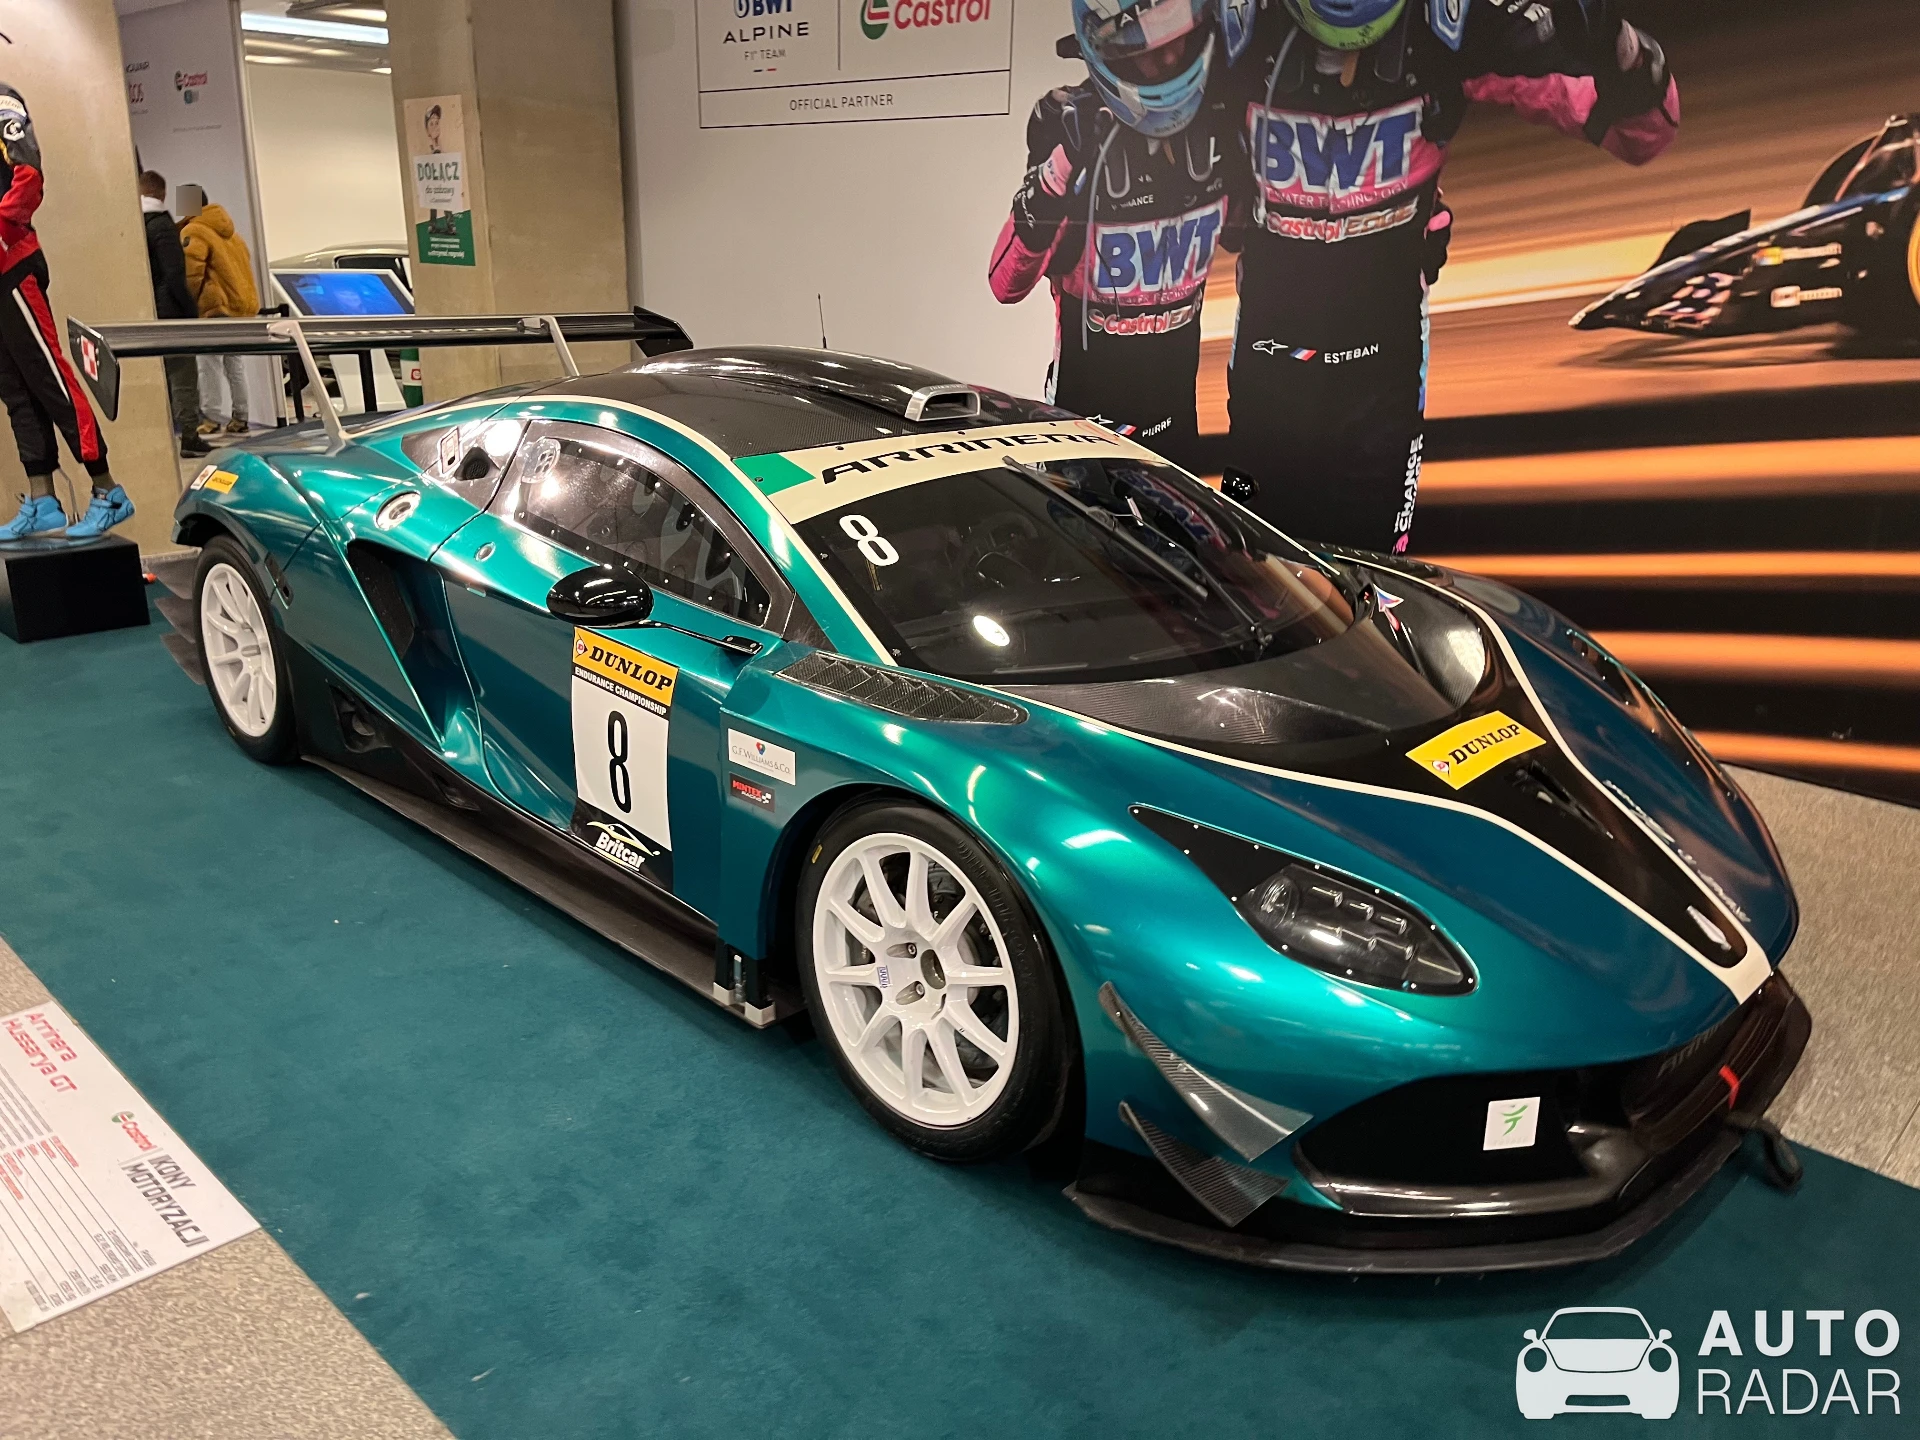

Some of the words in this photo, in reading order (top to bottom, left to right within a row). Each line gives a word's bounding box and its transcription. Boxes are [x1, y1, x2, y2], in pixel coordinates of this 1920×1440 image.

[722, 22, 809, 44] ALPINE
[893, 0, 991, 30] Castrol
[760, 48, 787, 60] TEAM
[789, 97, 839, 111] OFFICIAL
[841, 94, 894, 108] PARTNER
[1255, 110, 1418, 191] BWT
[1267, 211, 1344, 243] Castrol
[1097, 208, 1221, 289] BWT
[1105, 312, 1169, 334] Castrol
[1324, 343, 1380, 364] ESTEBAN
[1142, 416, 1172, 437] PIERRE
[822, 432, 1121, 485] ARRINERA
[839, 514, 899, 567] 8
[589, 646, 673, 690] DUNLOP
[575, 666, 615, 691] ENDURANCE
[615, 685, 667, 715] CHAMPIONSHIP
[607, 710, 632, 813] 8
[1448, 723, 1521, 765] DUNLOP
[732, 779, 763, 798] MINTEX
[595, 831, 646, 870] Britcar
[1, 1017, 58, 1076] Hussarya
[49, 1074, 78, 1093] GT
[24, 1013, 78, 1062] Arrinera
[147, 1154, 197, 1190] IKONY
[121, 1162, 211, 1248] MOTORYZACJI
